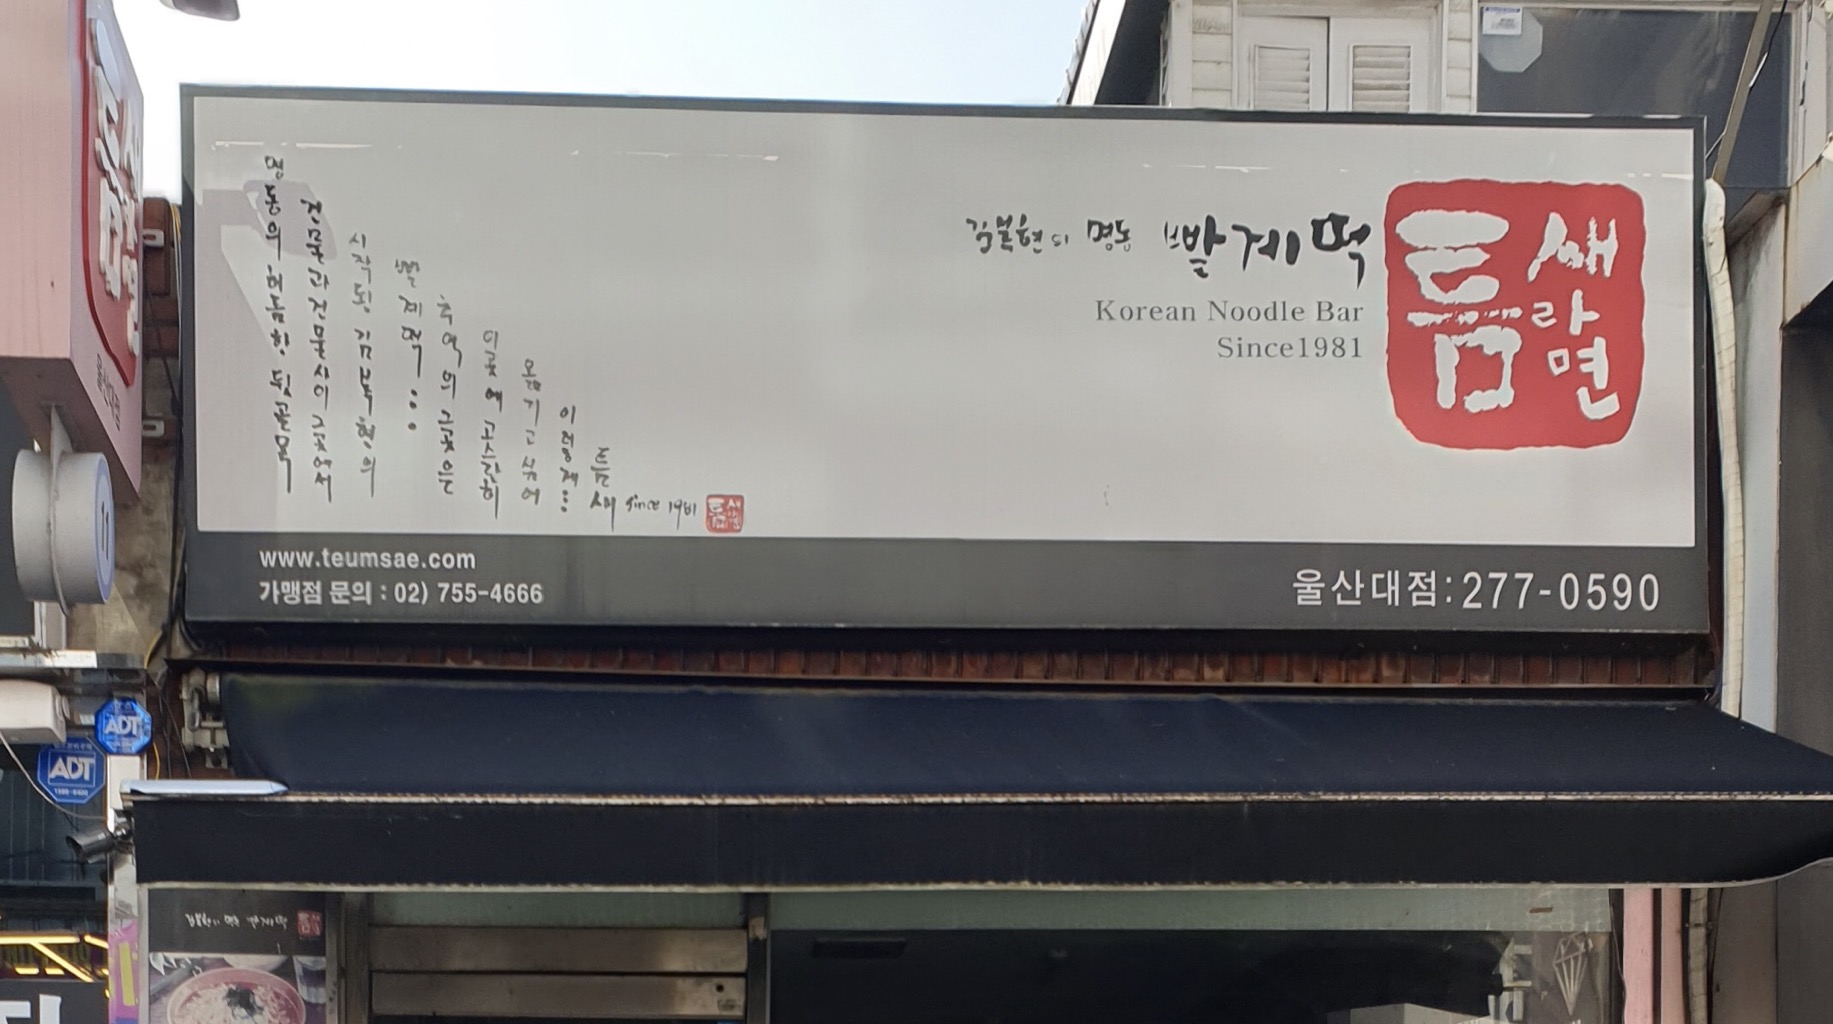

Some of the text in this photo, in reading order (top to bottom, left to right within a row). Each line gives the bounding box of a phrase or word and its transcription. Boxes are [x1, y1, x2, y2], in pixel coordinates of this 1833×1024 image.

[1087, 218, 1132, 252] 명동
[1095, 300, 1364, 322] Korean Noodle Bar
[1216, 335, 1363, 360] Since1981
[259, 548, 476, 570] www.teumsae.com
[259, 580, 323, 606] 가맹점
[329, 580, 373, 606] 문의
[393, 582, 428, 606] 02)
[437, 582, 544, 605] 755-4666
[105, 716, 141, 736] ADT
[50, 756, 95, 781] ADT
